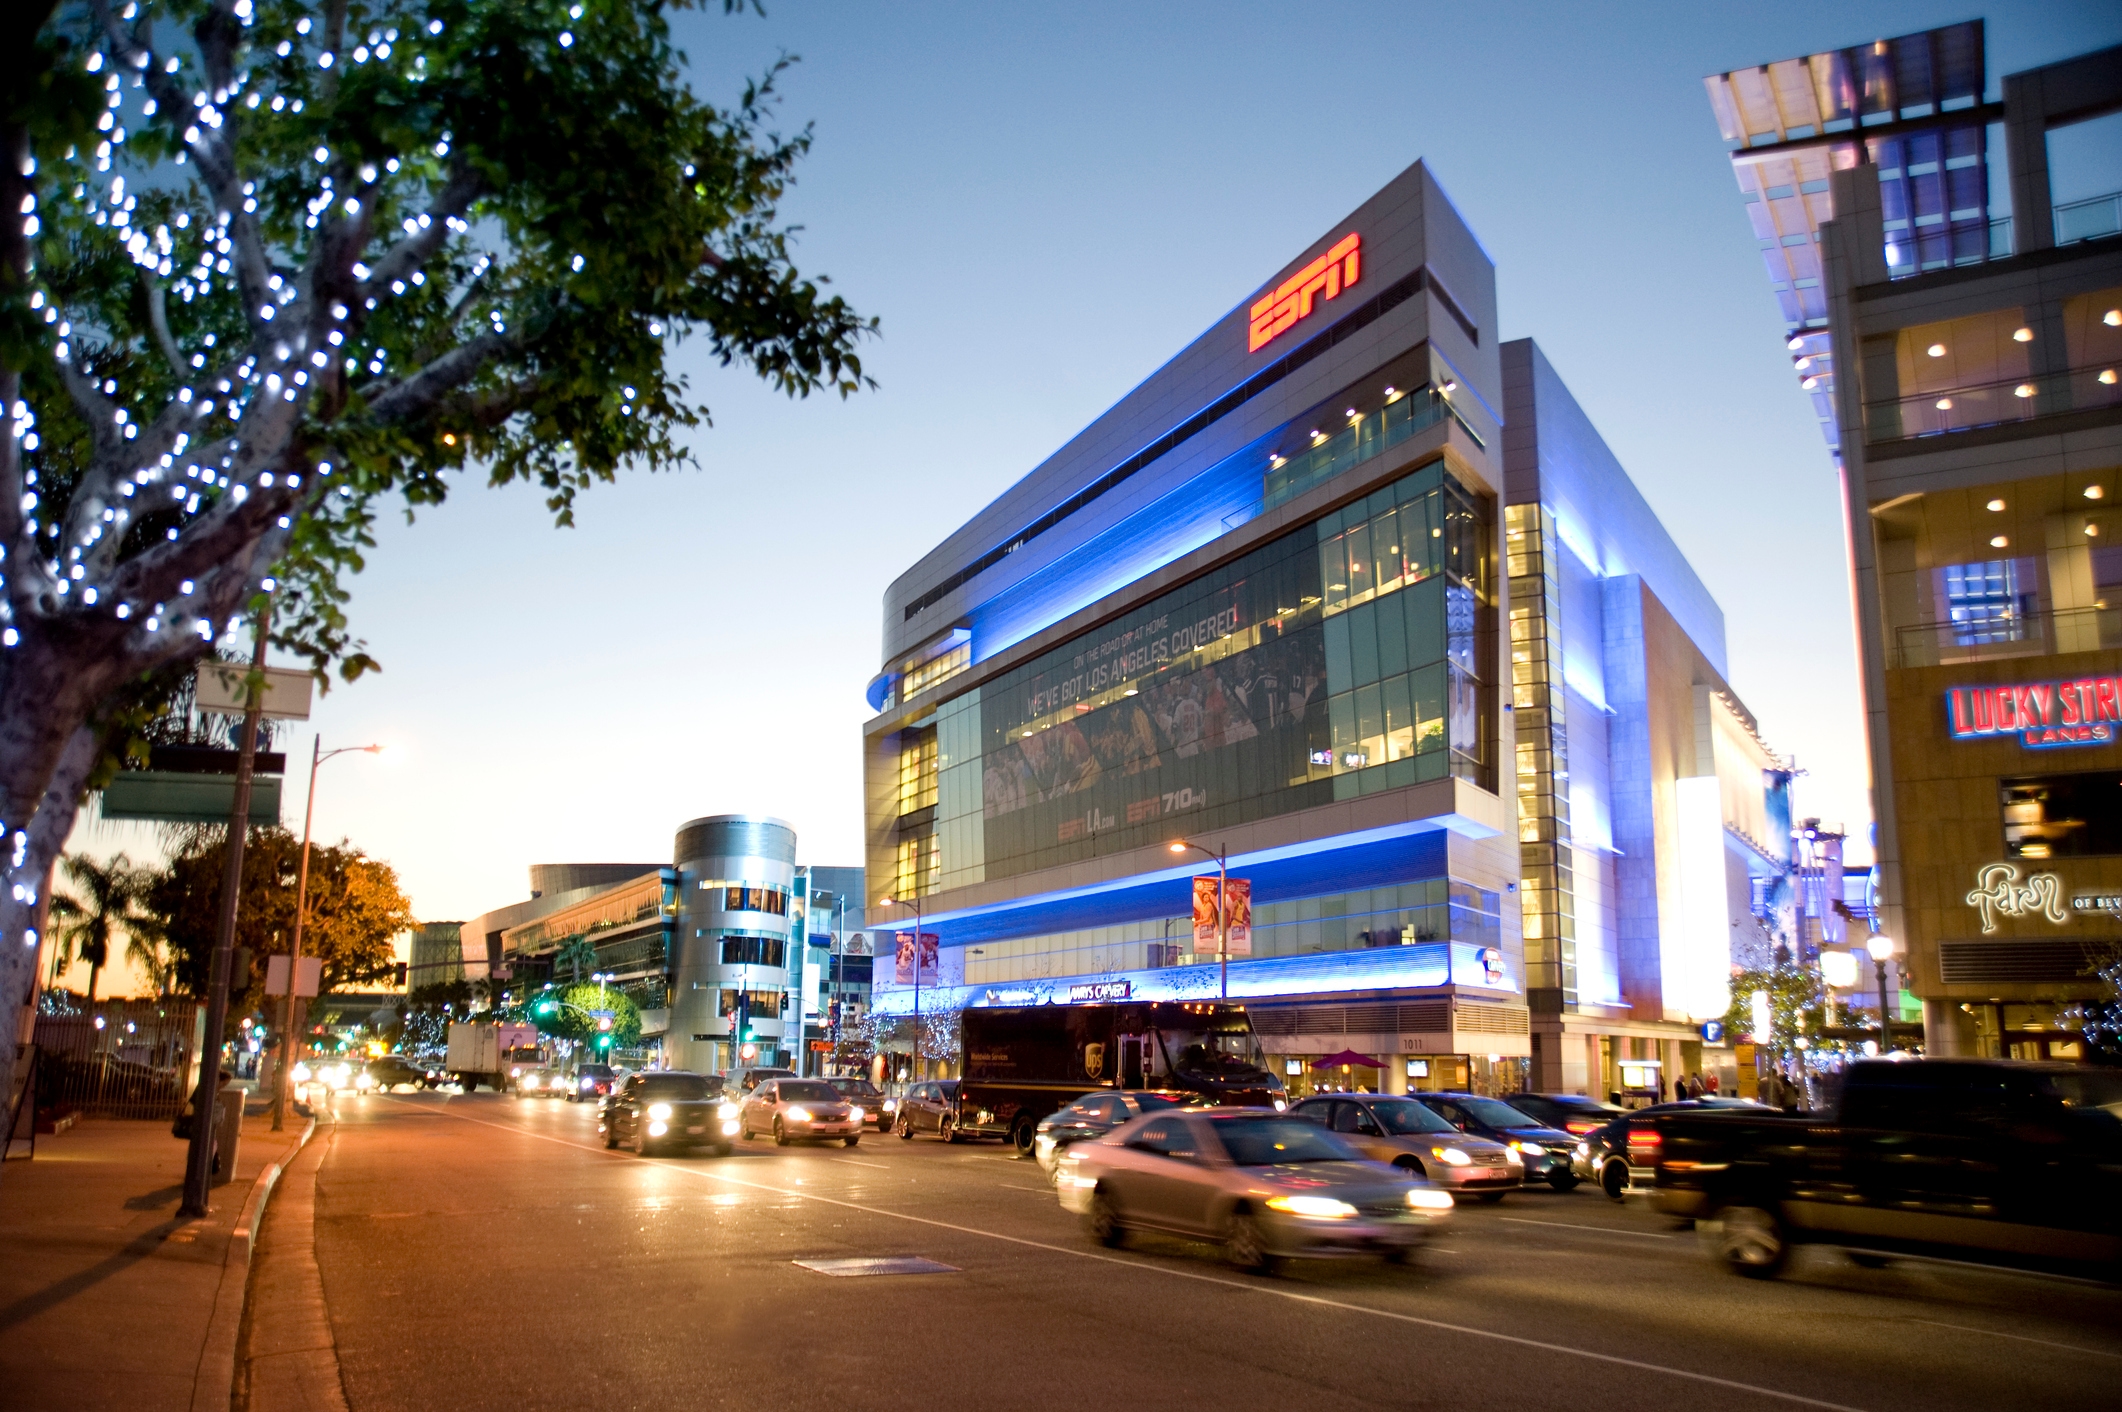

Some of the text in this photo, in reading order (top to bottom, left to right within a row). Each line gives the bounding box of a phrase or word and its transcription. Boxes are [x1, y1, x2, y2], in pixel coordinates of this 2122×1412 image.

[1249, 232, 1361, 353] ESPN
[1073, 614, 1169, 670] ON THE ROAD OR AT HOME
[1027, 607, 1236, 715] WE'VE GOT LOS ANGELES COVERED
[1952, 684, 2051, 735] LUCKY
[2026, 725, 2109, 744] LANES
[1127, 796, 1161, 824] ESPN
[1162, 787, 1192, 814] 710
[1058, 818, 1086, 840] ESPN
[2074, 897, 2091, 908] OF
[1403, 1039, 1422, 1050] 1011
[1086, 1053, 1102, 1074] ups
